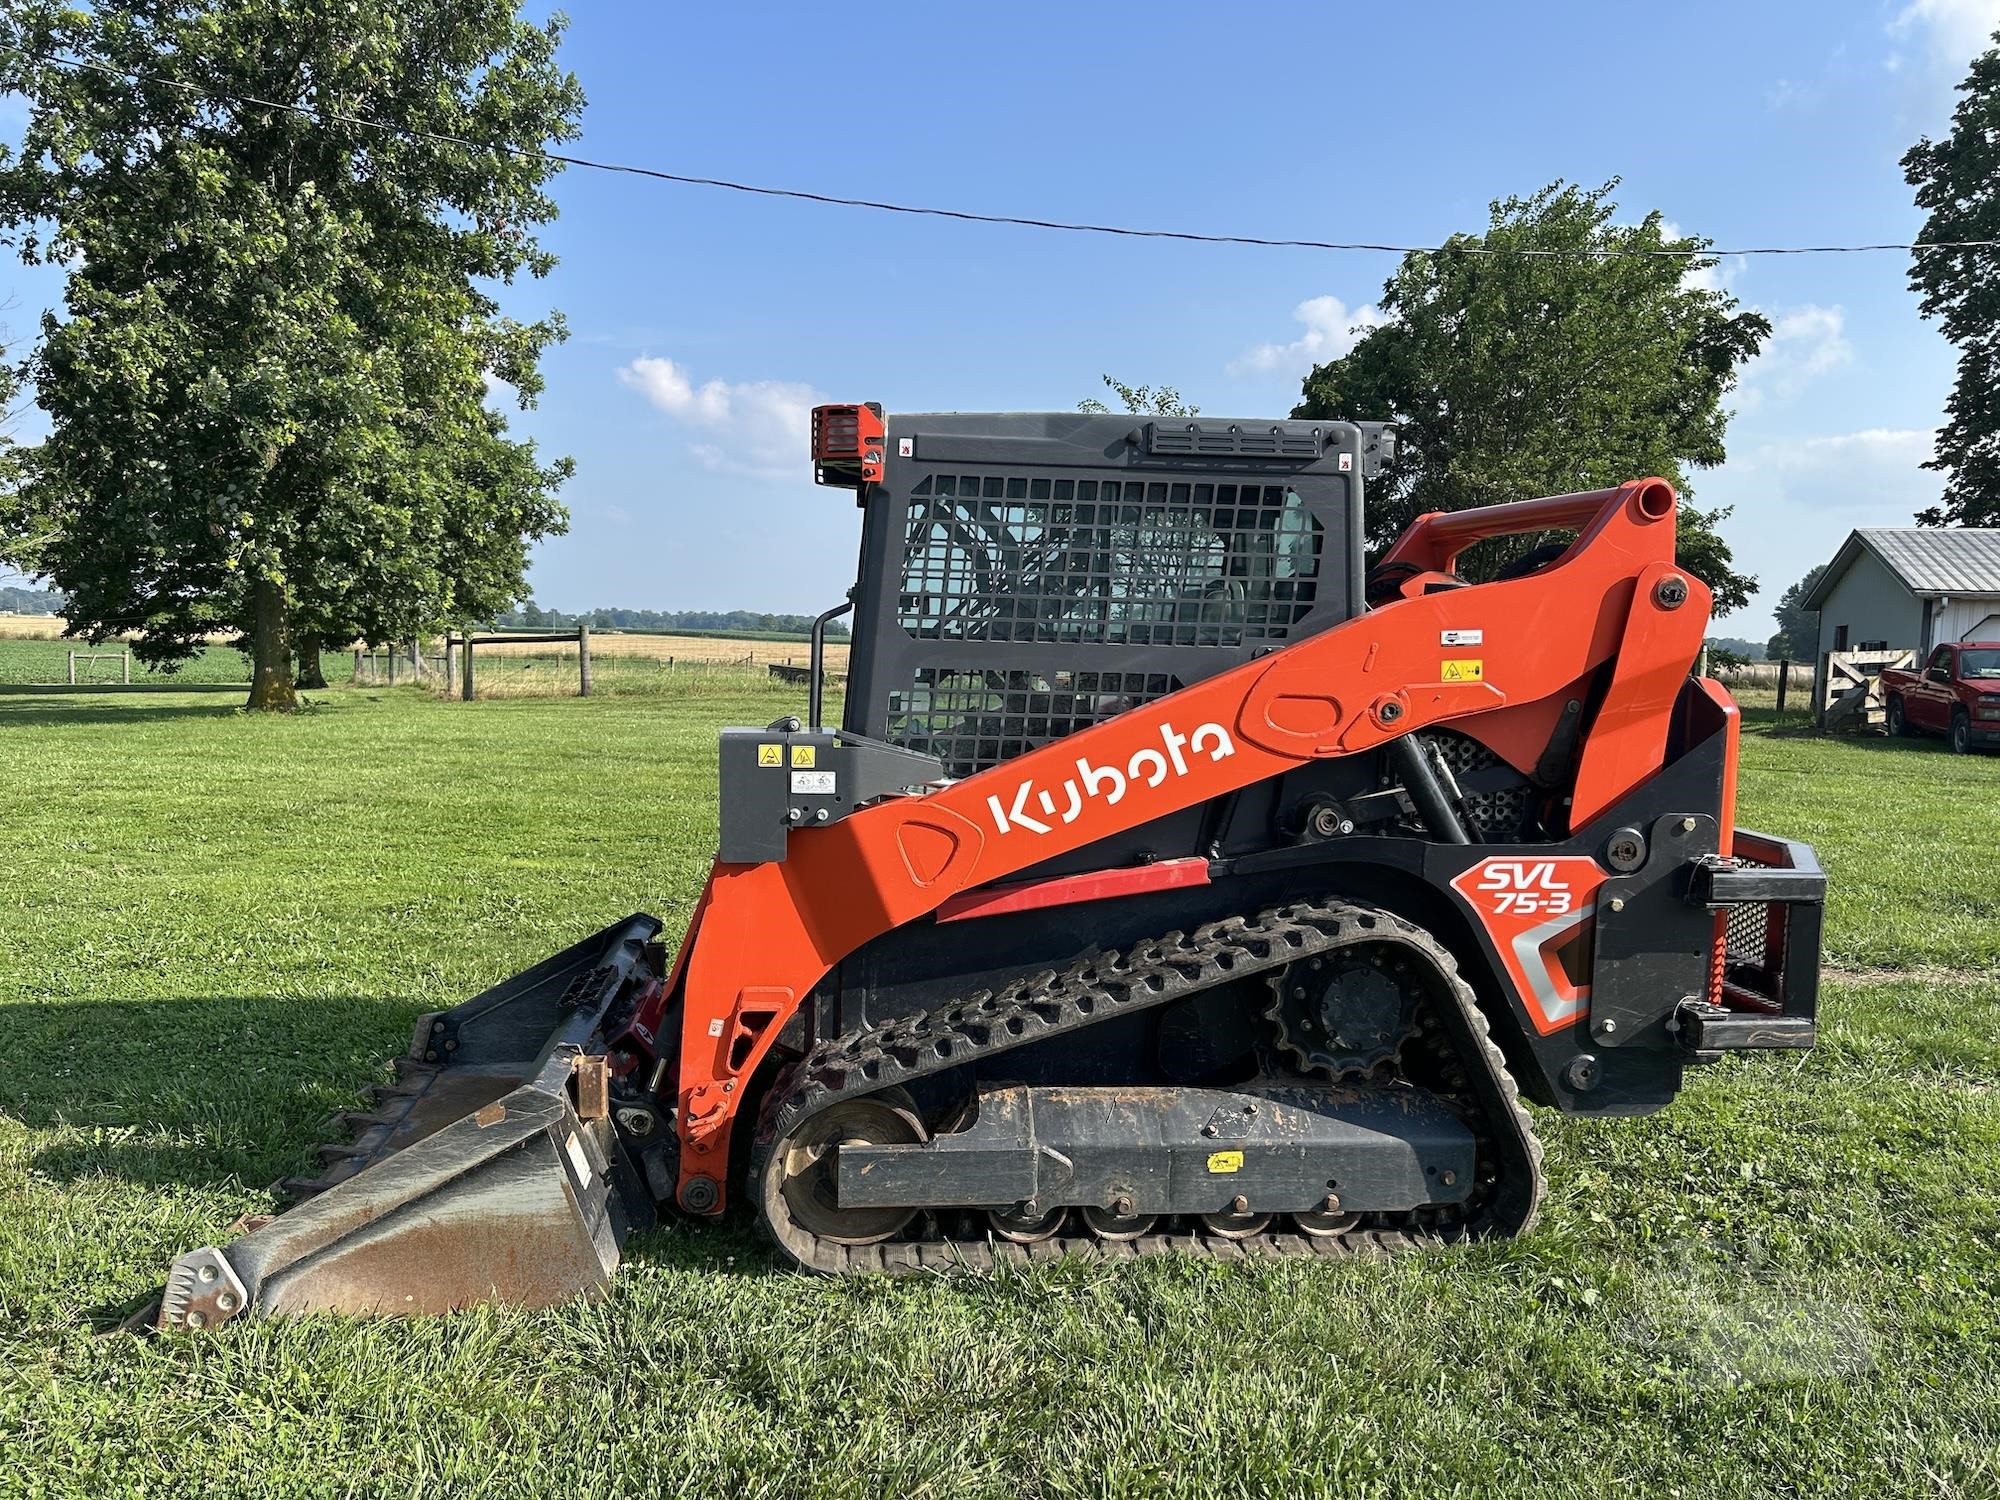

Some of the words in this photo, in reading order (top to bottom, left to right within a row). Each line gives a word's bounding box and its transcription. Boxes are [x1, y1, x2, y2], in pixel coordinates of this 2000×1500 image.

[987, 722, 1235, 835] Kubota
[1477, 863, 1569, 890] SVL
[1493, 892, 1571, 914] 75-3
